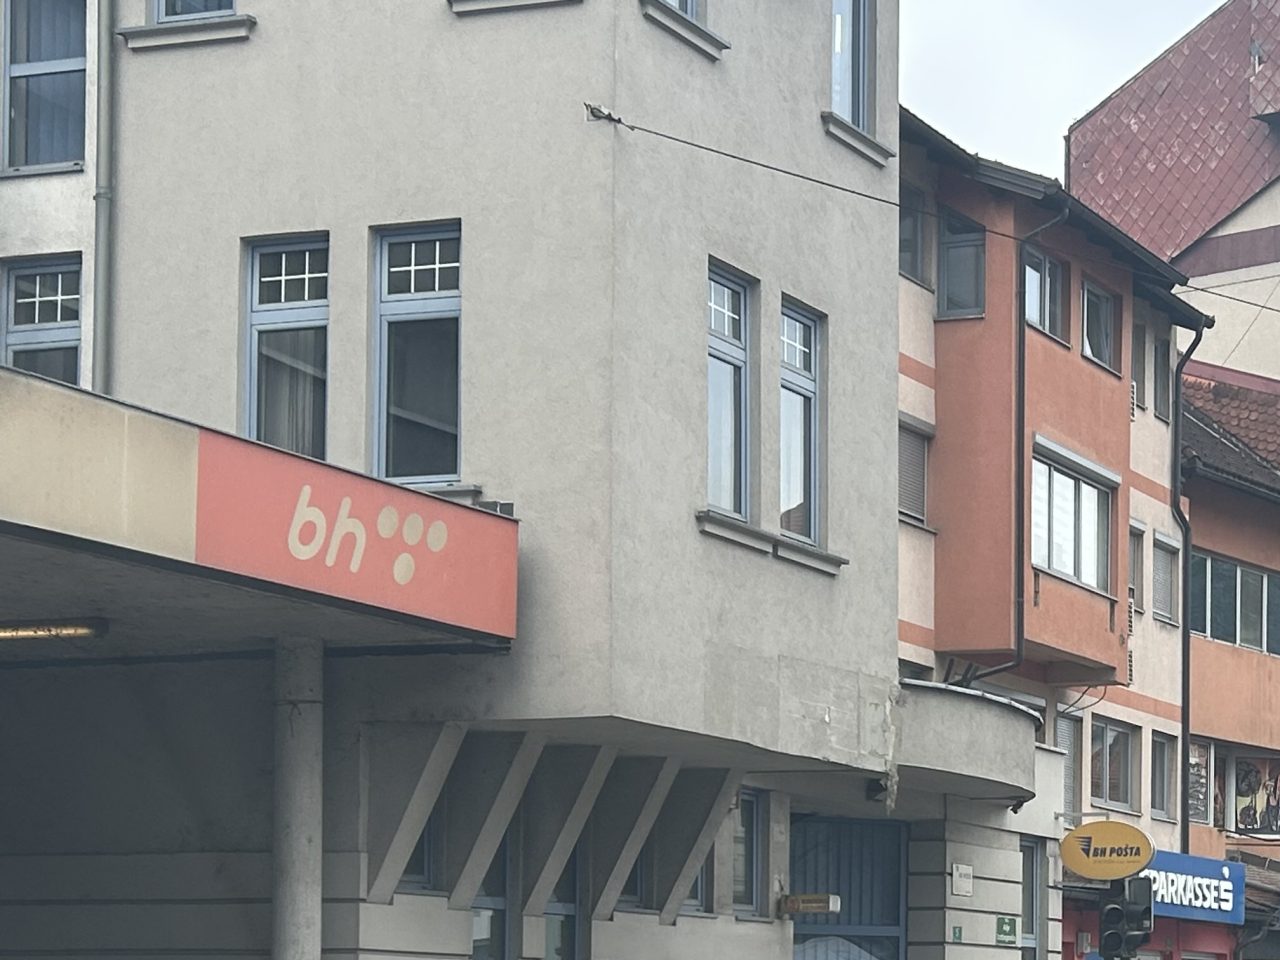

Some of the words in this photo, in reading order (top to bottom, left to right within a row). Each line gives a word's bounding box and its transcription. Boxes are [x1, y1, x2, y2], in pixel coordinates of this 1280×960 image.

[287, 484, 367, 574] bh
[1092, 847, 1107, 858] BH
[1109, 844, 1141, 858] POŠTA
